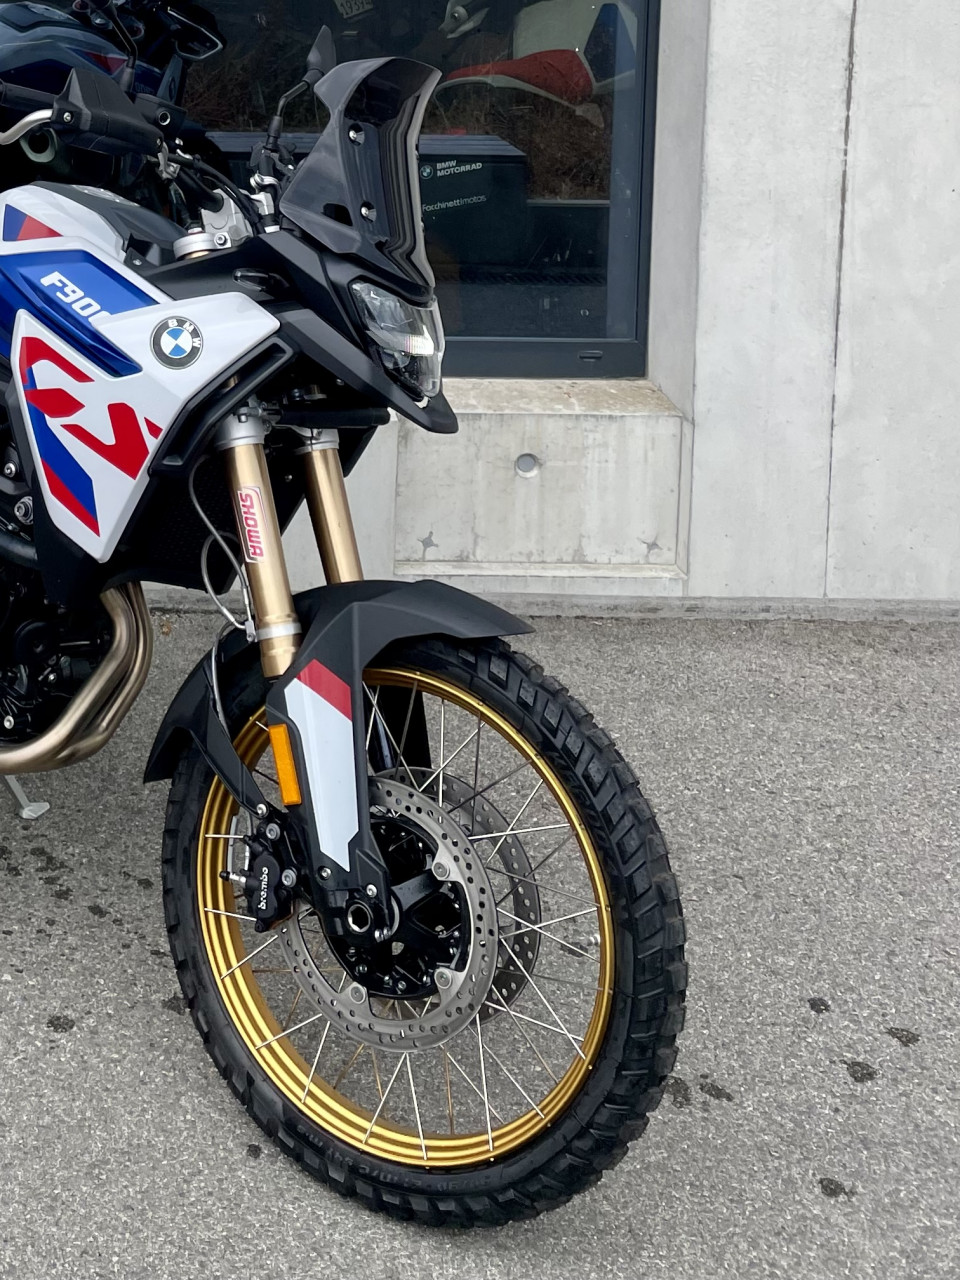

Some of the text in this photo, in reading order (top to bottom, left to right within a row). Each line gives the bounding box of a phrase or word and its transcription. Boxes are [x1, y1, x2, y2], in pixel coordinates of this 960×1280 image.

[436, 160, 457, 170] BMW
[436, 162, 483, 177] MOTORRAD
[240, 492, 264, 558] SHOWA
[257, 866, 269, 910] brembo
